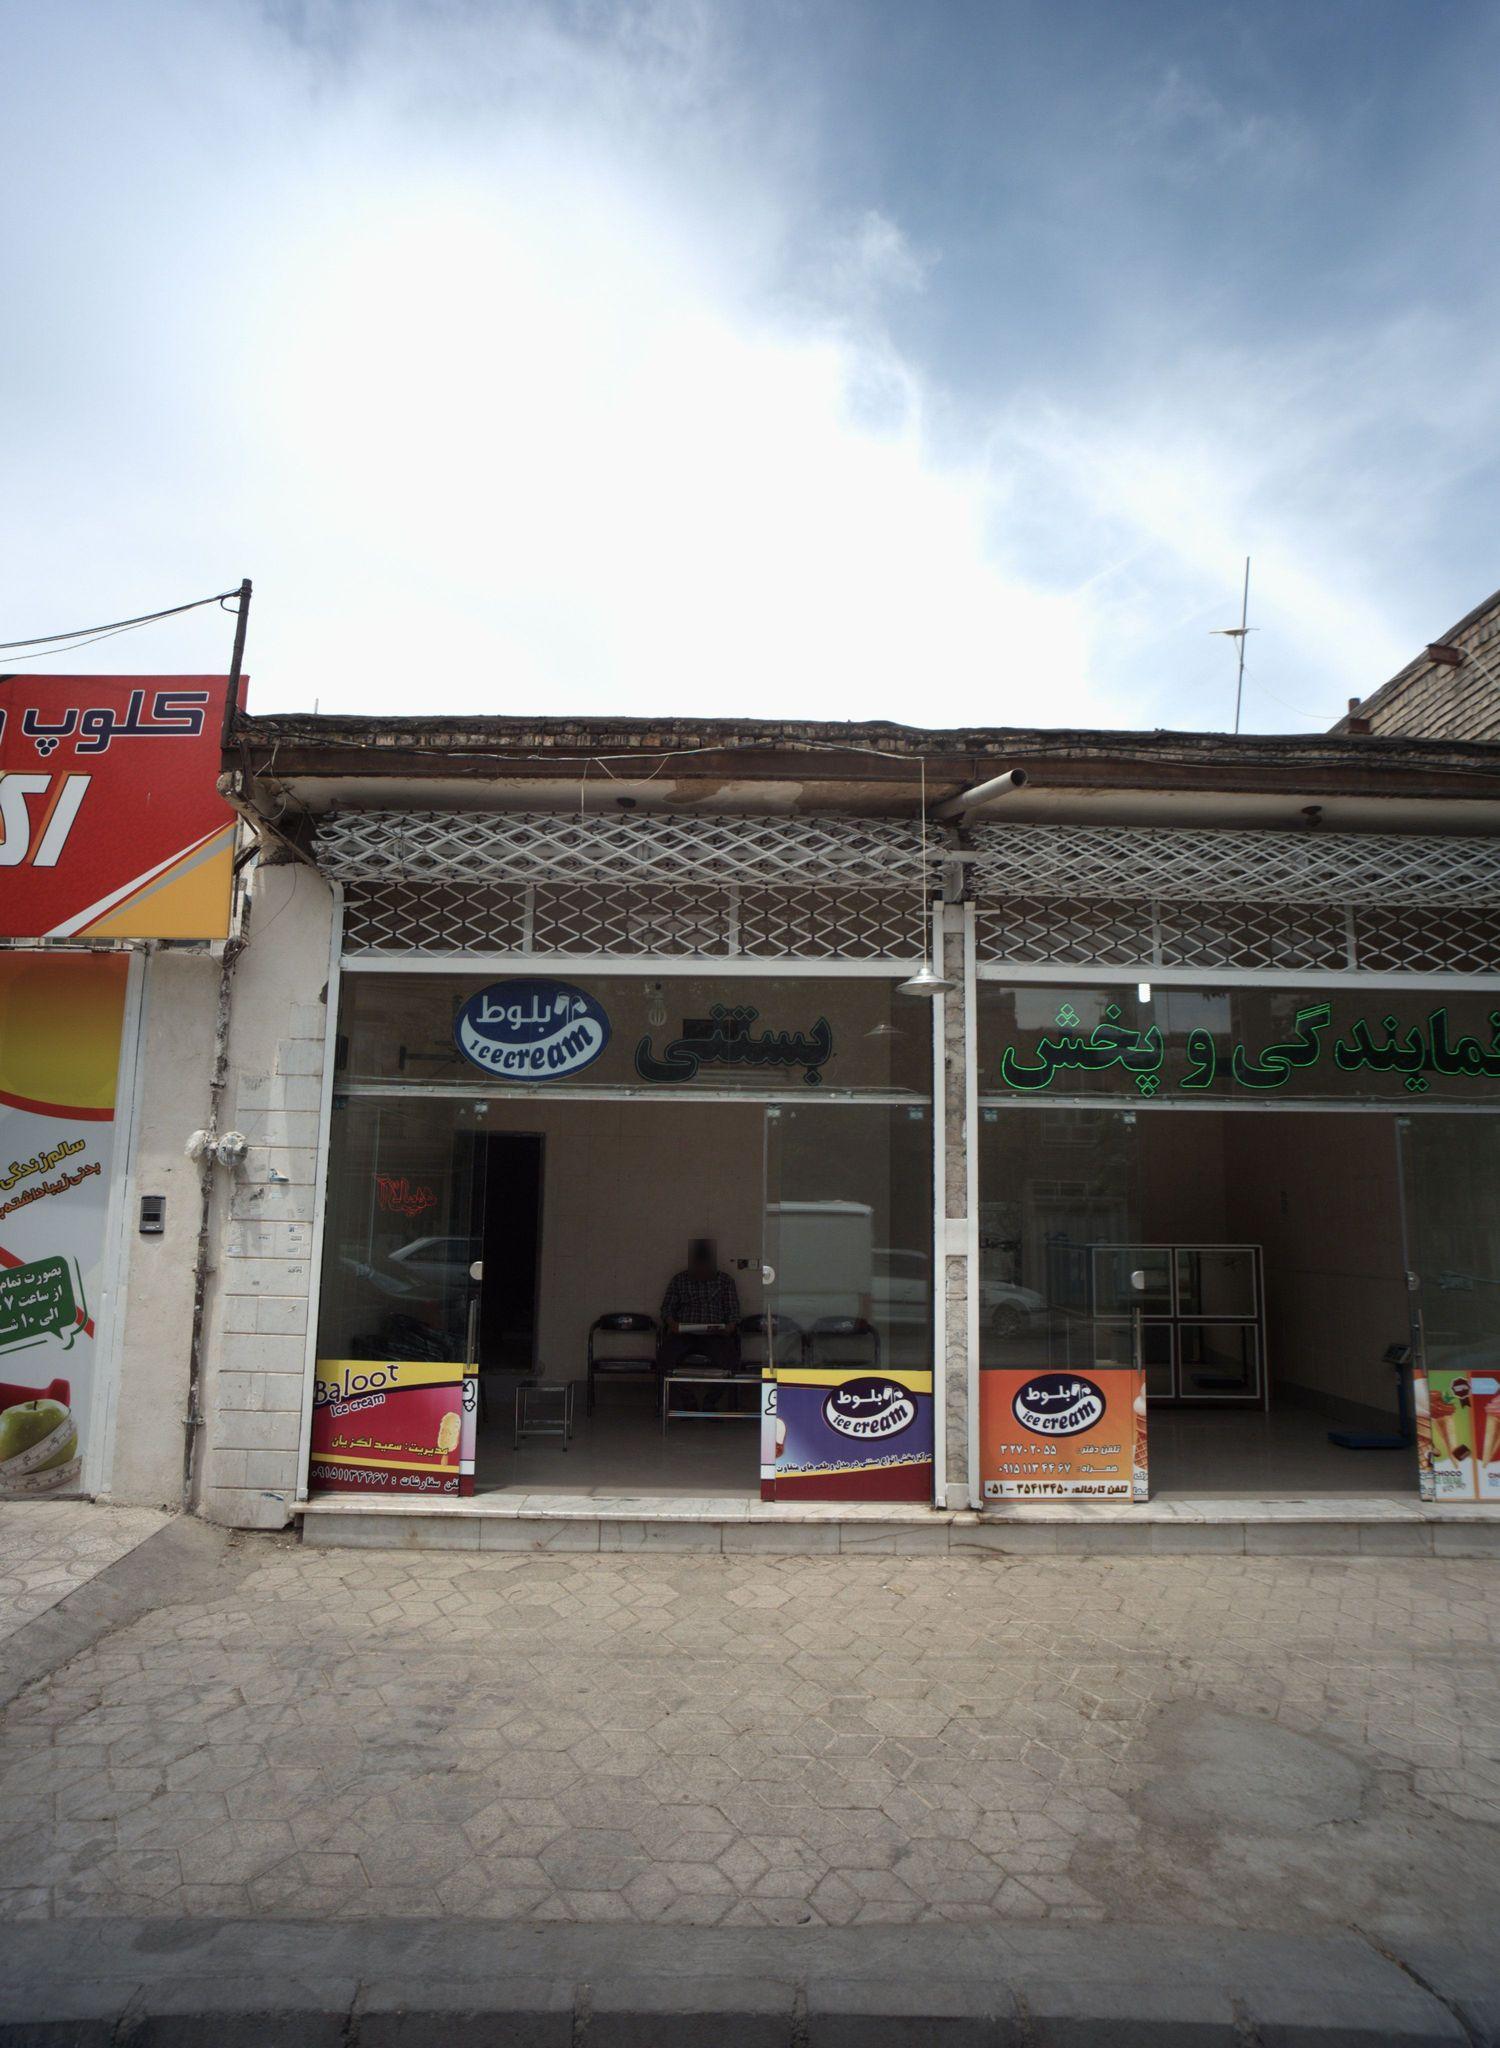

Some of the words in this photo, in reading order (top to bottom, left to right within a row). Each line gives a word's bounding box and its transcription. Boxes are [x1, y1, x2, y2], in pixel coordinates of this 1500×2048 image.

[21, 689, 210, 757] کلوپ
[475, 994, 552, 1033] بلوط
[633, 1002, 833, 1087] بستنی
[1001, 1002, 1165, 1098] پخش
[1179, 1027, 1216, 1088] و
[46, 1139, 86, 1170] سالم
[0, 1151, 49, 1191] زندگی
[69, 1162, 102, 1186] بدنی
[41, 1173, 71, 1196] زیبا
[3, 1188, 46, 1214] داشته
[0, 1274, 22, 1294] تمام
[24, 1267, 62, 1285] بصورت
[3, 1295, 14, 1311] ۷
[18, 1290, 50, 1307] ساعت
[53, 1284, 63, 1302] از
[21, 1313, 35, 1329] ۱۰
[39, 1307, 59, 1327] الی
[314, 1364, 400, 1404] Baloot
[330, 1404, 350, 1417] Ice
[350, 1393, 386, 1412] cream
[836, 1388, 883, 1410] بلوط
[1025, 1385, 1071, 1405] بلوط
[832, 1414, 851, 1430] ice
[852, 1404, 909, 1434] cream
[1021, 1410, 1040, 1426] ice
[1042, 1400, 1097, 1430] cream
[374, 1440, 402, 1452] سعید
[1043, 1444, 1057, 1455] ۵۵
[1100, 1444, 1121, 1455] تلفن
[800, 1462, 814, 1472] های
[880, 1454, 898, 1466] انواع
[898, 1452, 916, 1464] پخش
[915, 1451, 932, 1463] مرکز
[776, 1463, 800, 1473] متفاوت
[399, 1475, 441, 1491] سفارشات
[1107, 1484, 1128, 1495] تلفن
